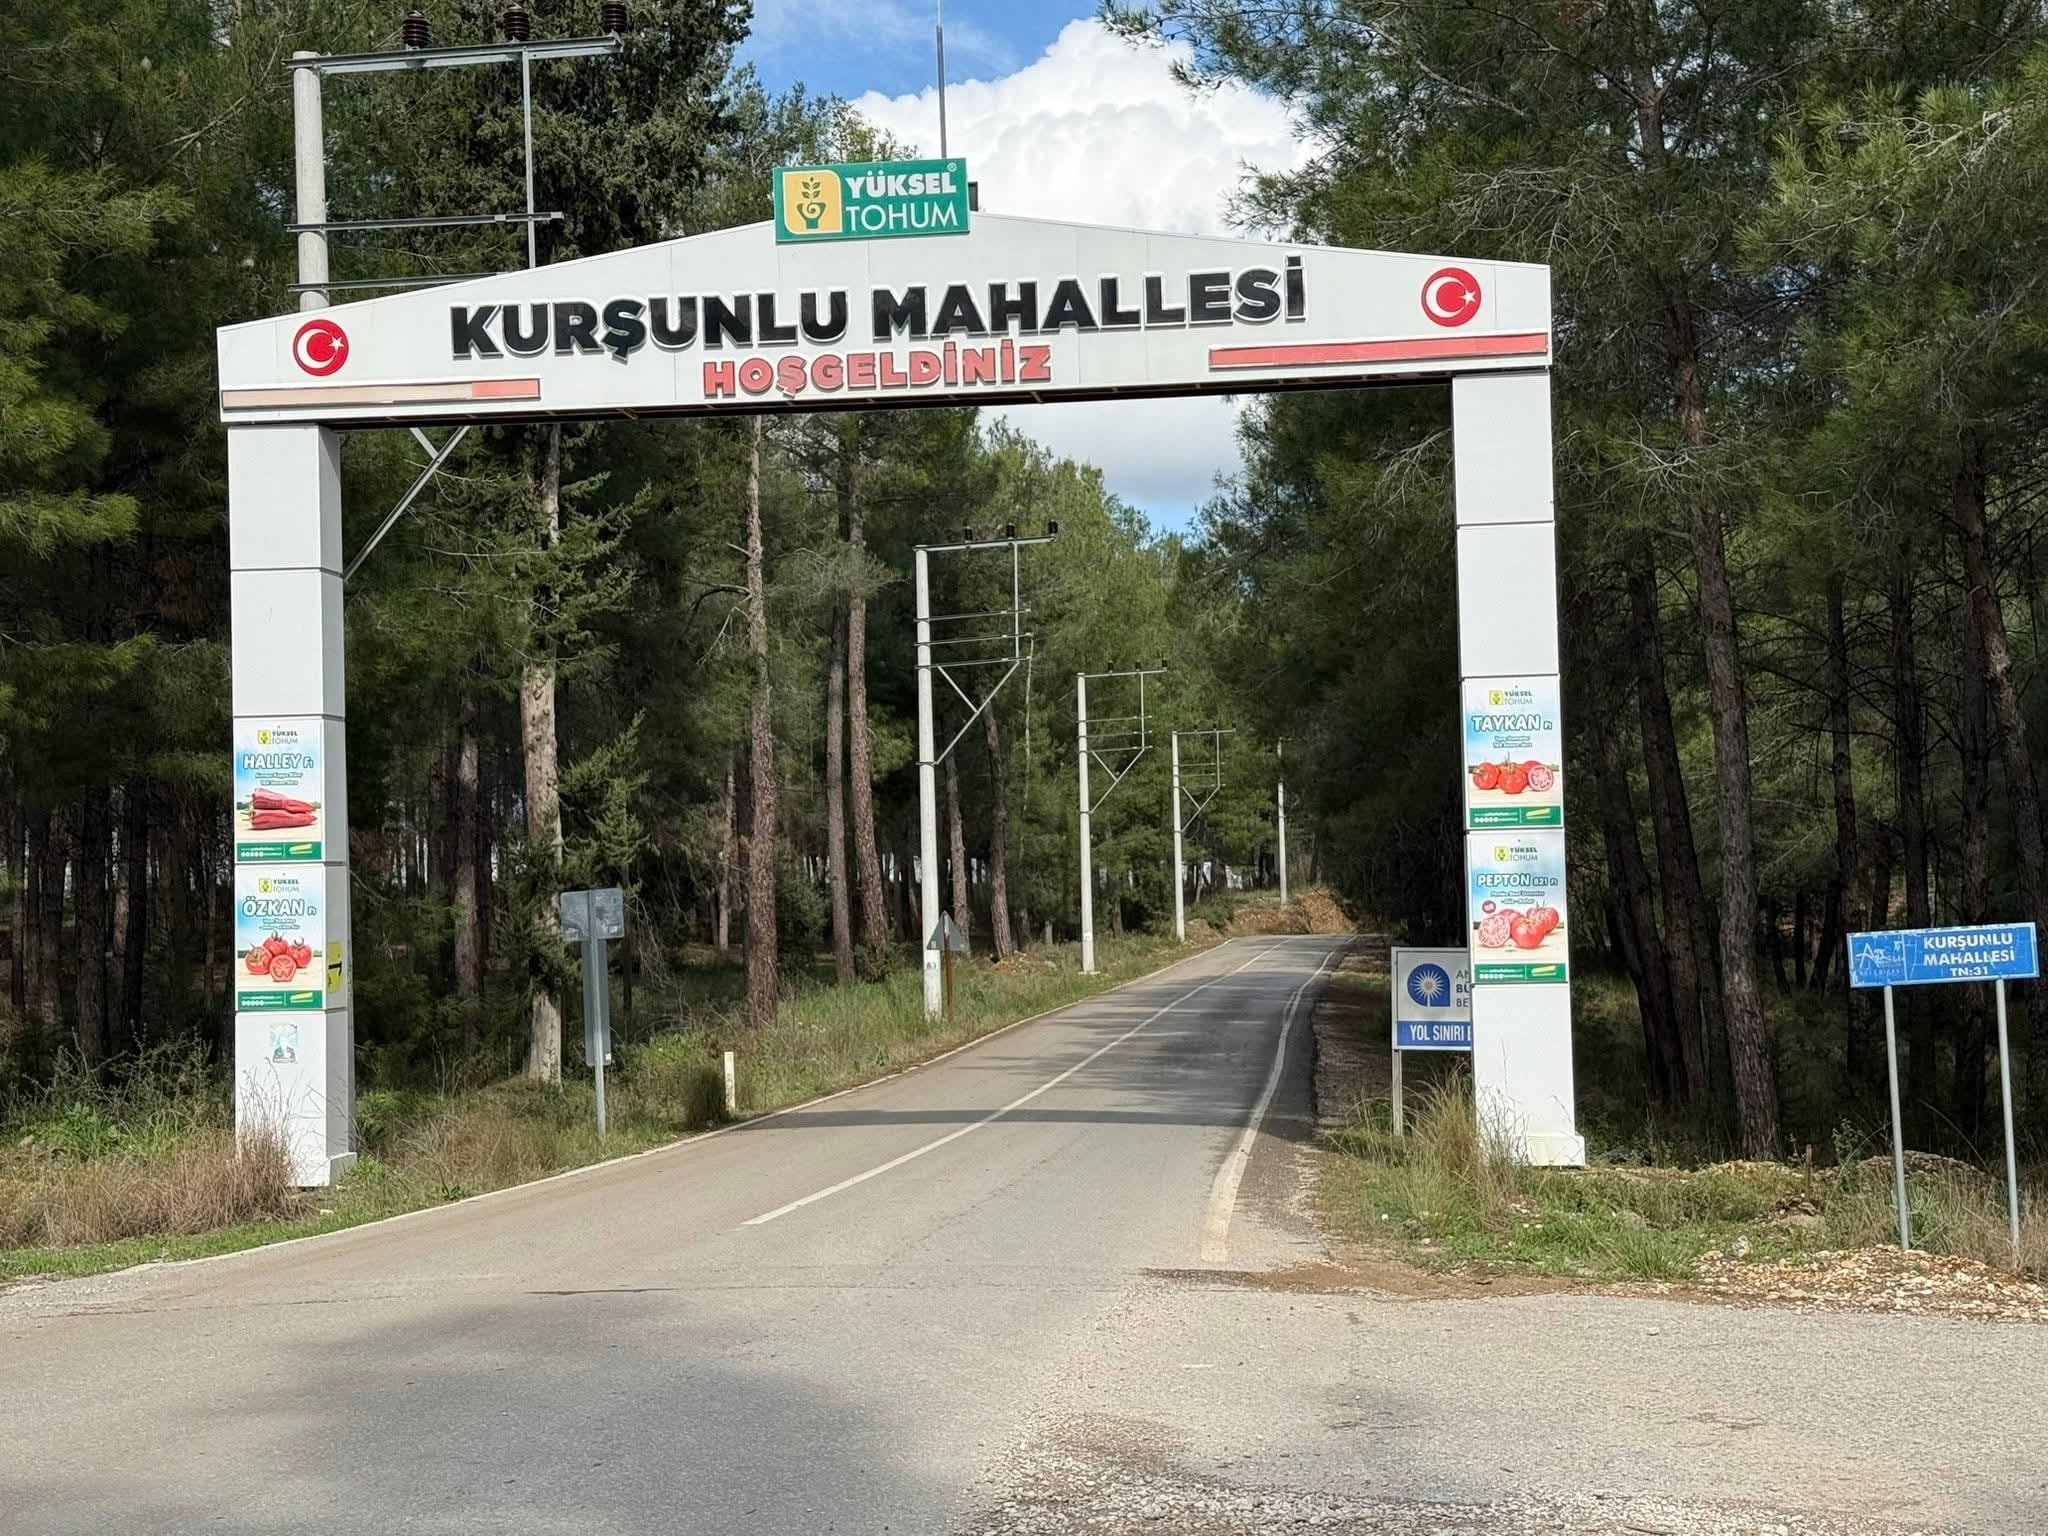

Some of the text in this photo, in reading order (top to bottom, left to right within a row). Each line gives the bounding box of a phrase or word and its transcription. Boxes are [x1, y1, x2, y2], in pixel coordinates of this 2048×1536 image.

[845, 170, 956, 199] YÜKSEL
[845, 201, 958, 232] TOHUM
[450, 254, 1305, 365] KURŞUNLU MAHALLESİ
[703, 338, 1052, 398] HOŞGELDİNİZ
[1471, 713, 1541, 732] TAYKAN
[243, 753, 302, 770] HALLEY
[1477, 873, 1531, 888] PEPTON
[242, 896, 305, 917] ÖZKAN
[1923, 932, 2013, 950] KURŞUNLU
[1923, 946, 2015, 966] MAHALLESİ
[1950, 966, 1988, 976] TN:31
[1409, 1025, 1431, 1041] YOL
[1432, 1024, 1464, 1041] SINIRI
